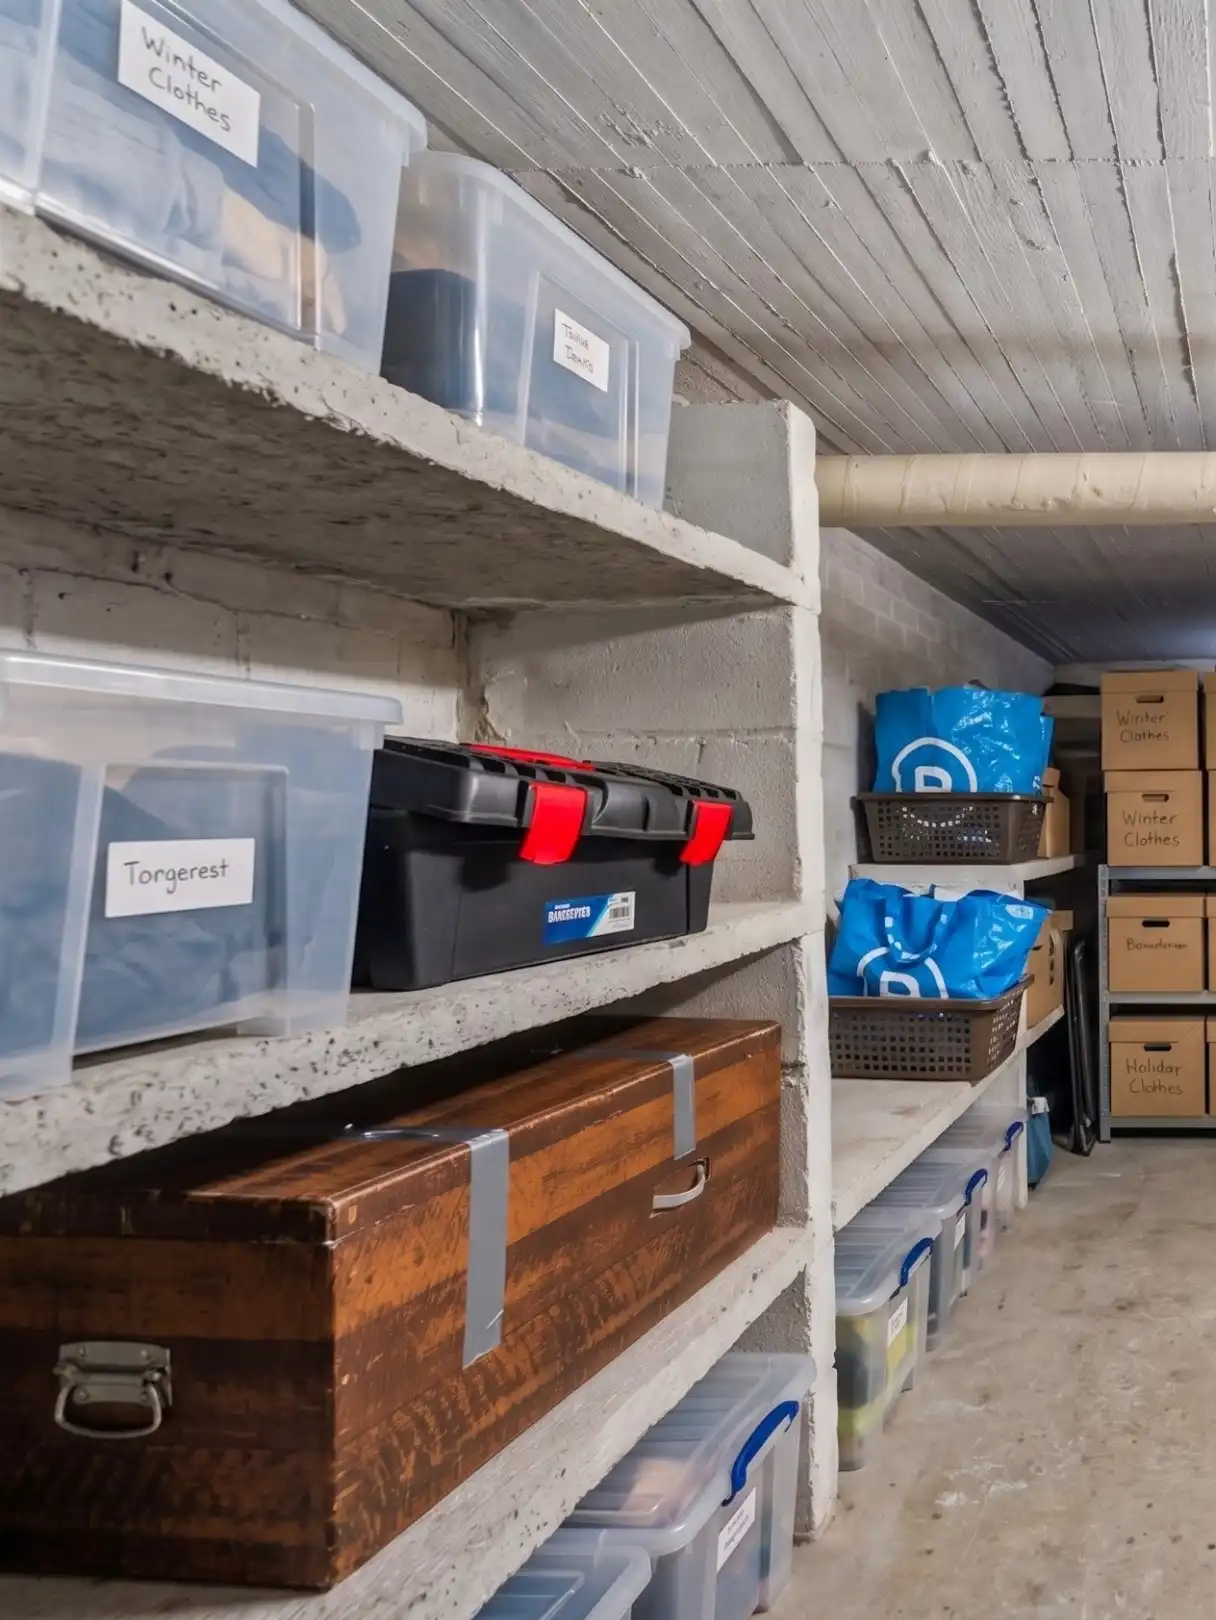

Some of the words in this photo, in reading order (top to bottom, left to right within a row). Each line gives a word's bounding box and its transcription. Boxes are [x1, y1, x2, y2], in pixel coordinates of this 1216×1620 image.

[141, 25, 222, 92] Winter
[148, 66, 231, 132] Clothes
[1116, 709, 1167, 726] Winter
[1119, 729, 1170, 743] Clothes
[1121, 809, 1178, 826] Winter
[1123, 831, 1181, 847] Clothes
[123, 858, 229, 895] Torgerest
[1128, 1078, 1184, 1096] Clothes
